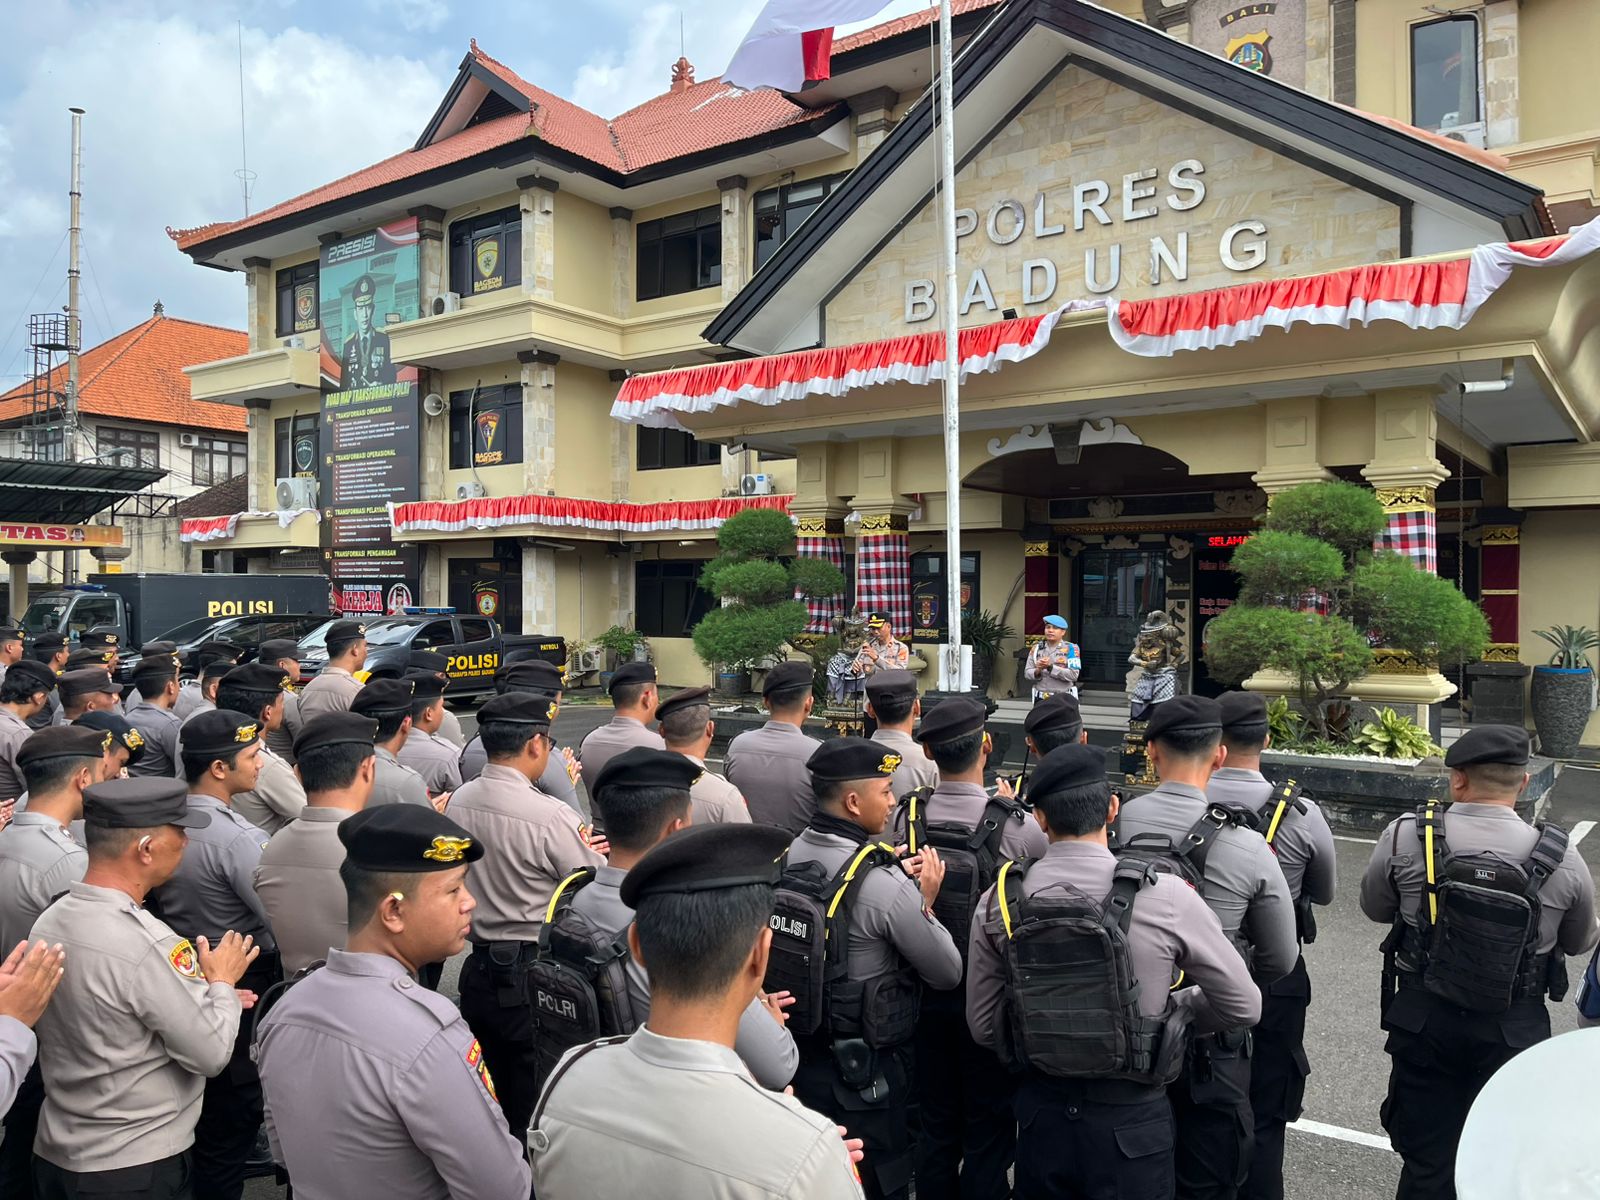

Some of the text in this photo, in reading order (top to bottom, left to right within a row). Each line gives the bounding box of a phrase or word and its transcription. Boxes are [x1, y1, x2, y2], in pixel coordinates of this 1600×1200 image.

[1226, 5, 1269, 22] BALI
[955, 159, 1206, 254] POLRES
[328, 234, 376, 260] PRESISI
[905, 219, 1268, 324] BADUNG
[351, 383, 393, 404] TRANSFORMASI
[335, 409, 366, 419] TRANSFORMASI
[335, 452, 366, 461] TRANSFORMASI
[0, 525, 69, 540] TAS
[207, 600, 274, 618] POLISI
[342, 591, 383, 611] KERJA
[446, 653, 498, 671] POLISI
[769, 914, 808, 939] OLISI
[537, 990, 577, 1020] POLRI
